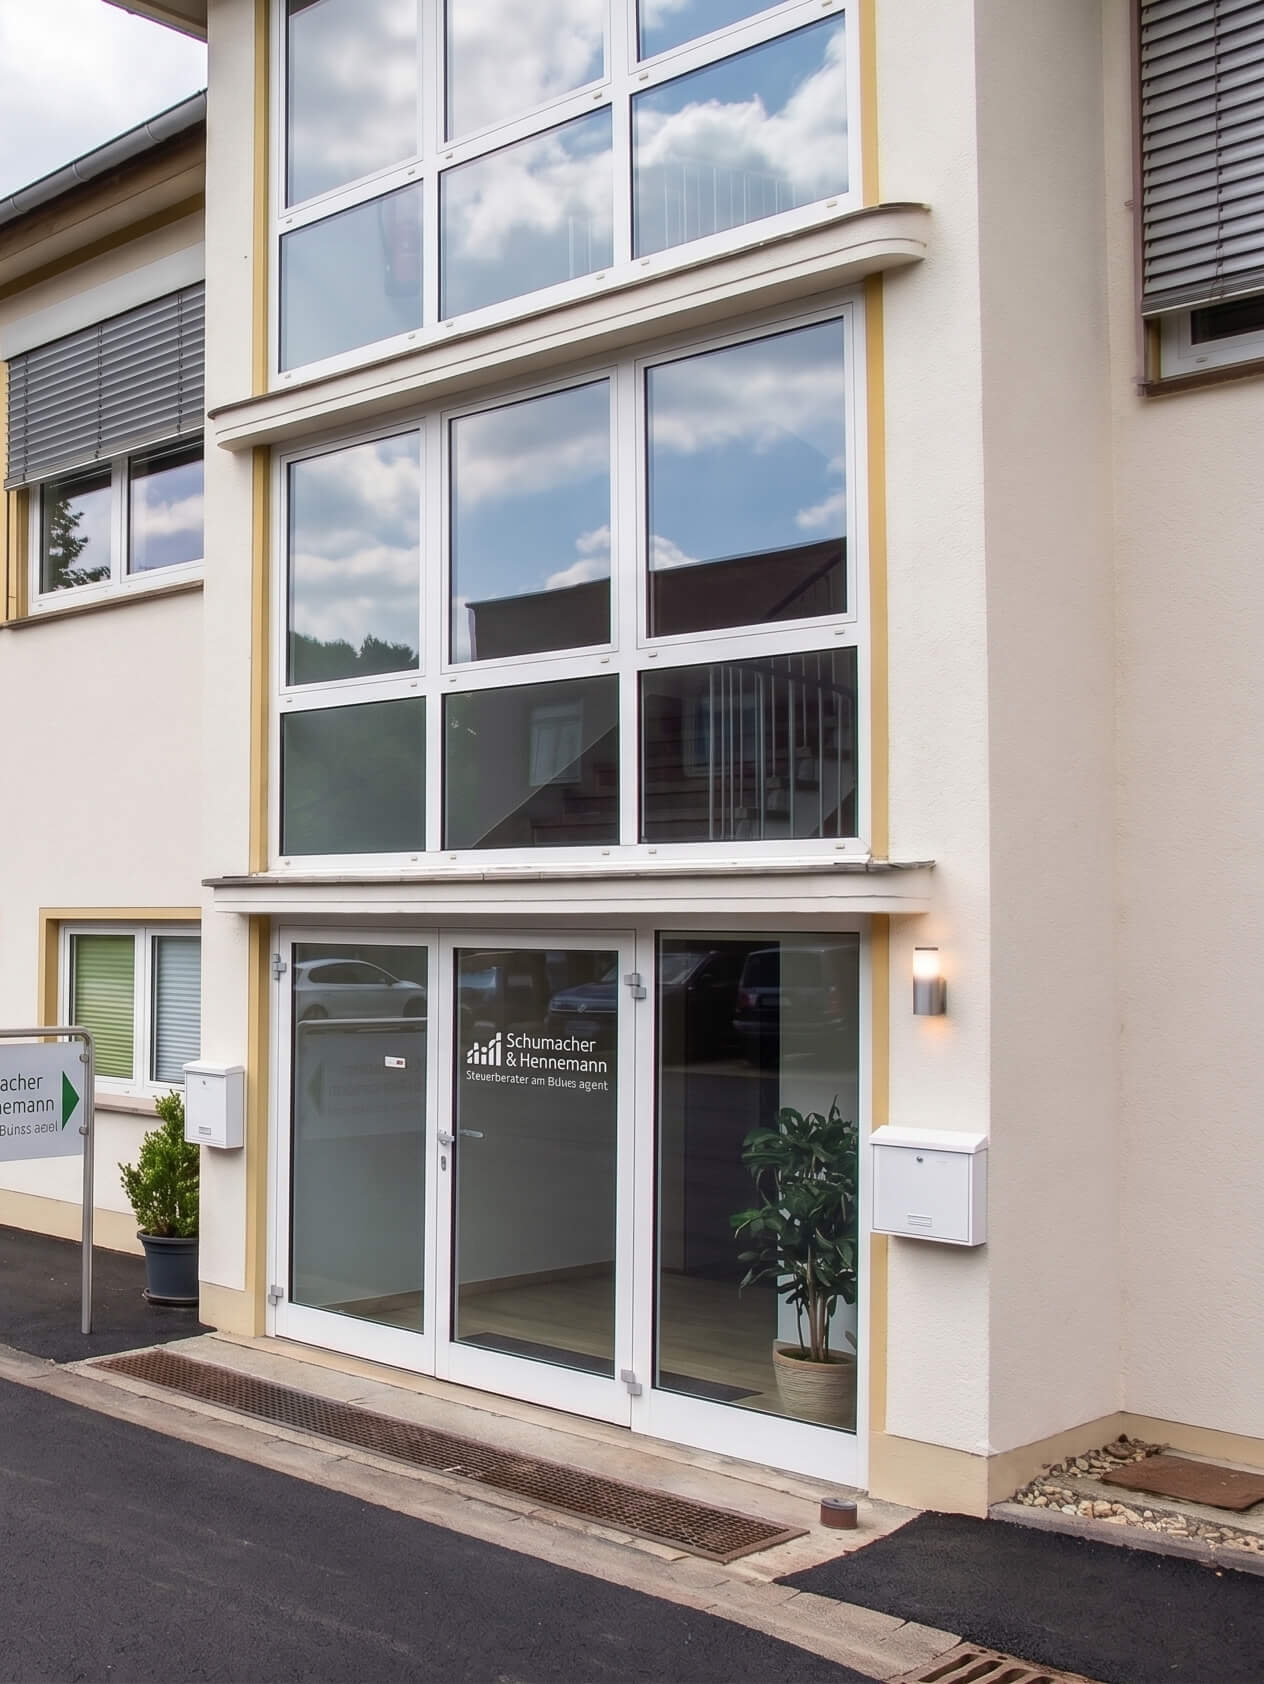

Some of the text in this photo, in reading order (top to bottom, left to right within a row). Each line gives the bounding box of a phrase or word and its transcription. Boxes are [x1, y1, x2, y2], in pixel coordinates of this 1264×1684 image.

[506, 1032, 597, 1052] Schumacher
[506, 1052, 608, 1073] & Hennemann
[466, 1070, 529, 1085] Steuerberater
[531, 1077, 545, 1087] am
